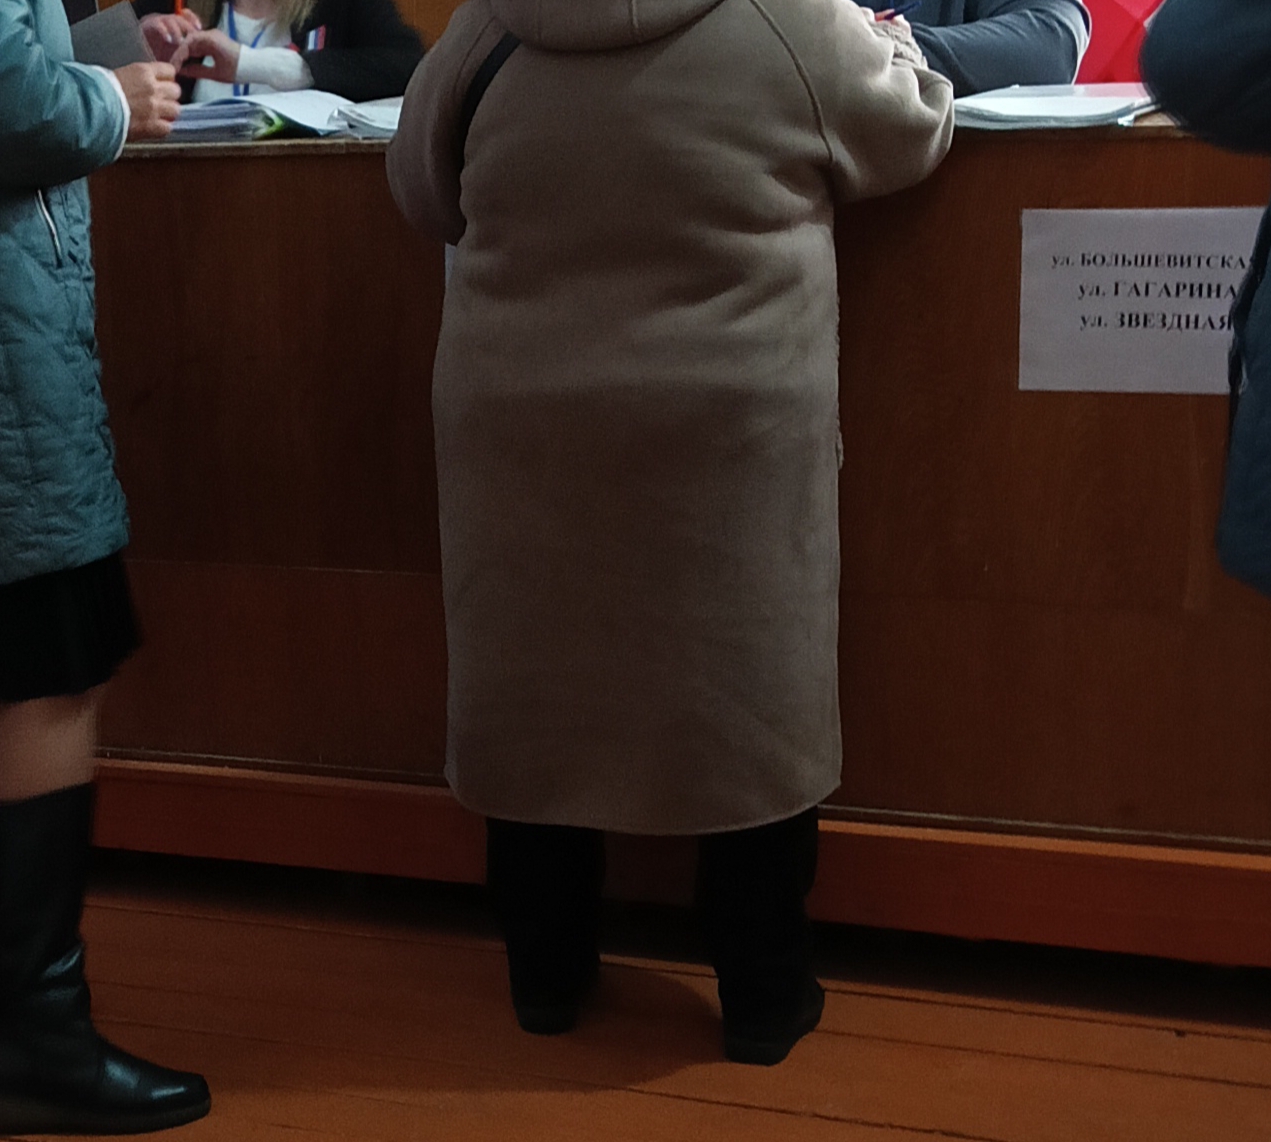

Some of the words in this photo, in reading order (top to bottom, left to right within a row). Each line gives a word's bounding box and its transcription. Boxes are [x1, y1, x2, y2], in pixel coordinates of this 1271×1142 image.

[1051, 255, 1075, 270] ул.
[1080, 252, 1252, 270] БОЛЬШЕВИТСКА
[1077, 283, 1106, 300] ул.
[1113, 280, 1237, 299] ГАГАРИНА
[1079, 314, 1108, 332] ул.
[1115, 311, 1232, 333] ЗВЕЗДНАЯ
